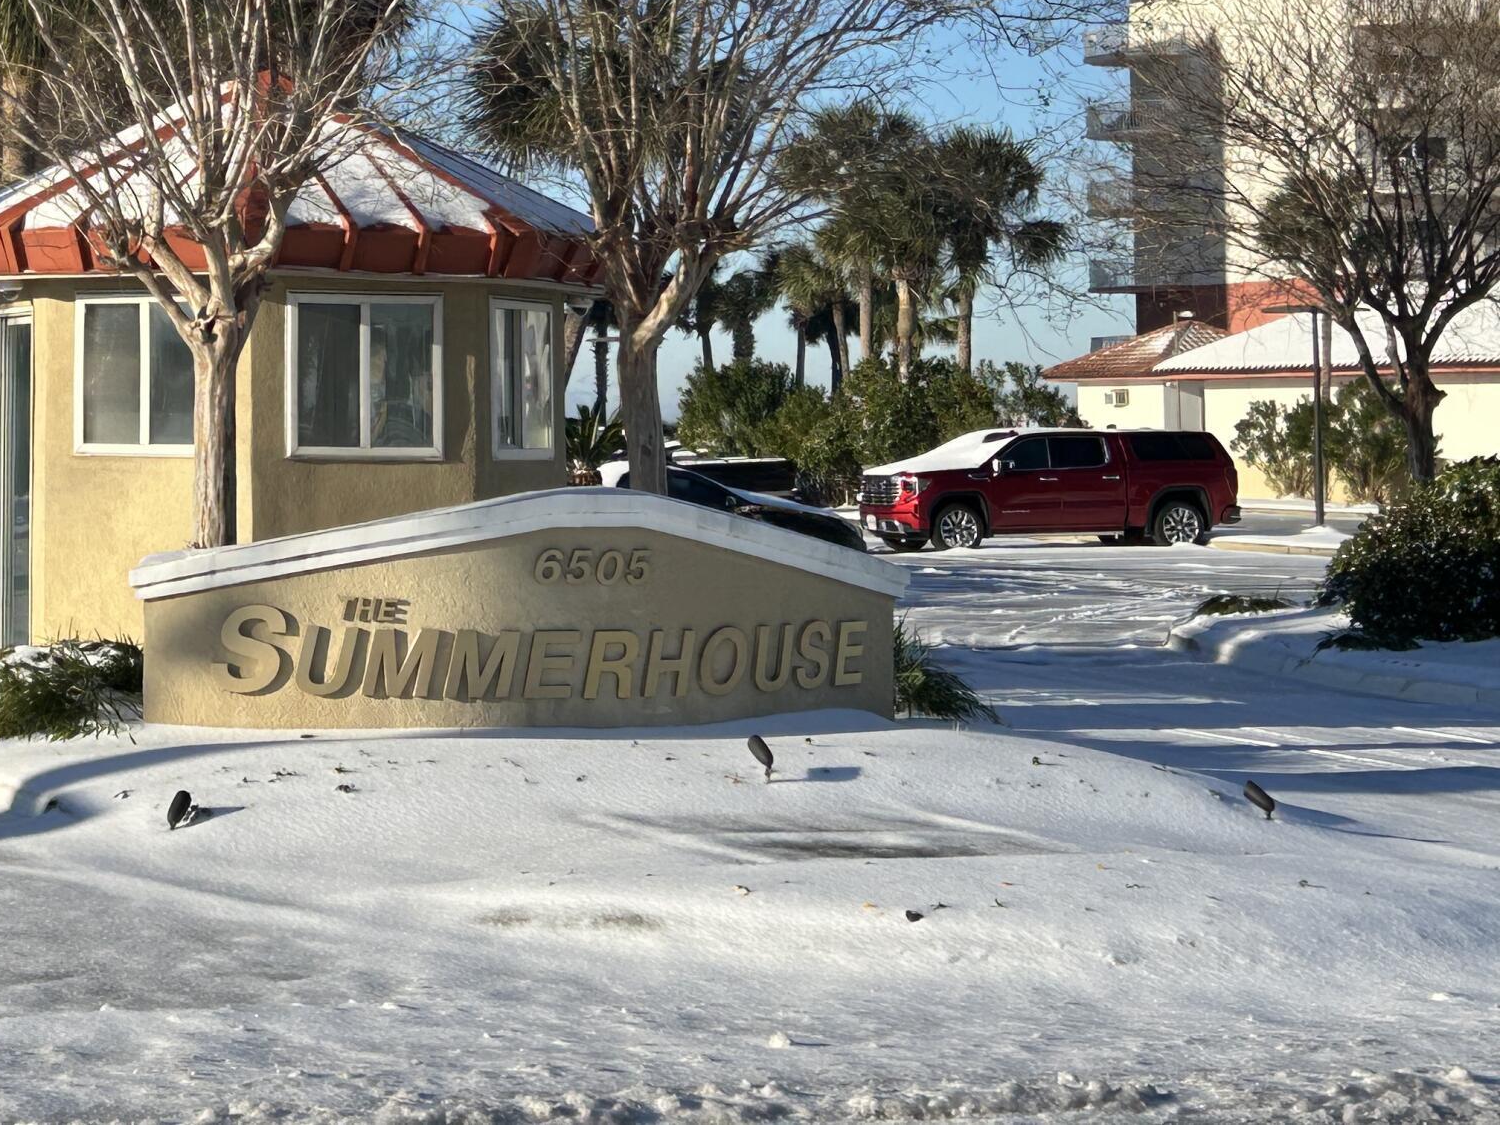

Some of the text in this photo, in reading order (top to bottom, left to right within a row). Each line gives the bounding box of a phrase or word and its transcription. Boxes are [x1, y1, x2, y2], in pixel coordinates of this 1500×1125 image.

[534, 548, 653, 586] 6505
[340, 596, 410, 624] THE
[211, 604, 868, 700] SUMMERHOUSE
